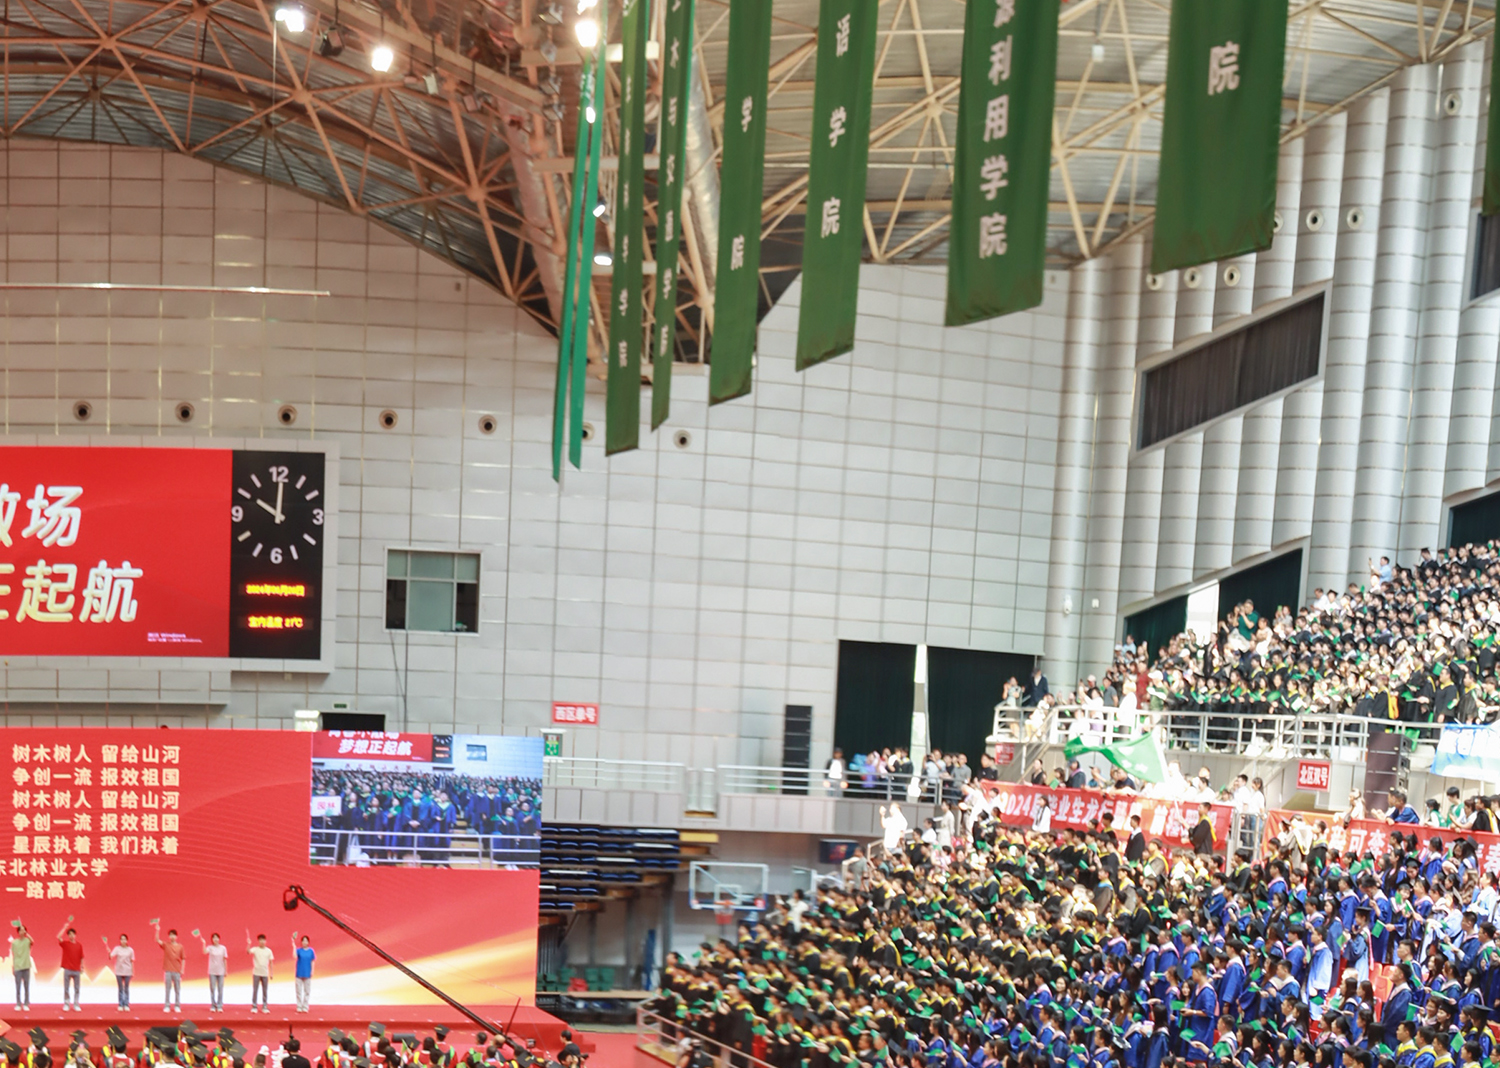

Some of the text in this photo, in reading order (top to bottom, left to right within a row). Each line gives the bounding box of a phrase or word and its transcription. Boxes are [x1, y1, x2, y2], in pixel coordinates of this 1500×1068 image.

[1207, 41, 1241, 97] 院
[269, 465, 289, 483] 12
[231, 505, 244, 522] 9
[312, 508, 324, 525] 3
[270, 547, 283, 564] 6
[555, 705, 597, 723] 西区单号
[12, 744, 92, 764] 树木树人
[101, 744, 181, 764] 留给山河
[338, 740, 413, 756] 梦想正起航
[12, 767, 92, 787] 争创一流
[101, 767, 181, 787] 报效祖国
[12, 790, 92, 810] 树木树人
[101, 790, 181, 810] 留给山河
[12, 813, 92, 832] 争创一流
[101, 813, 181, 832] 报效祖国
[12, 835, 92, 855] 星辰执着
[101, 835, 181, 855] 我们执着
[5, 880, 86, 900] 一路高歌
